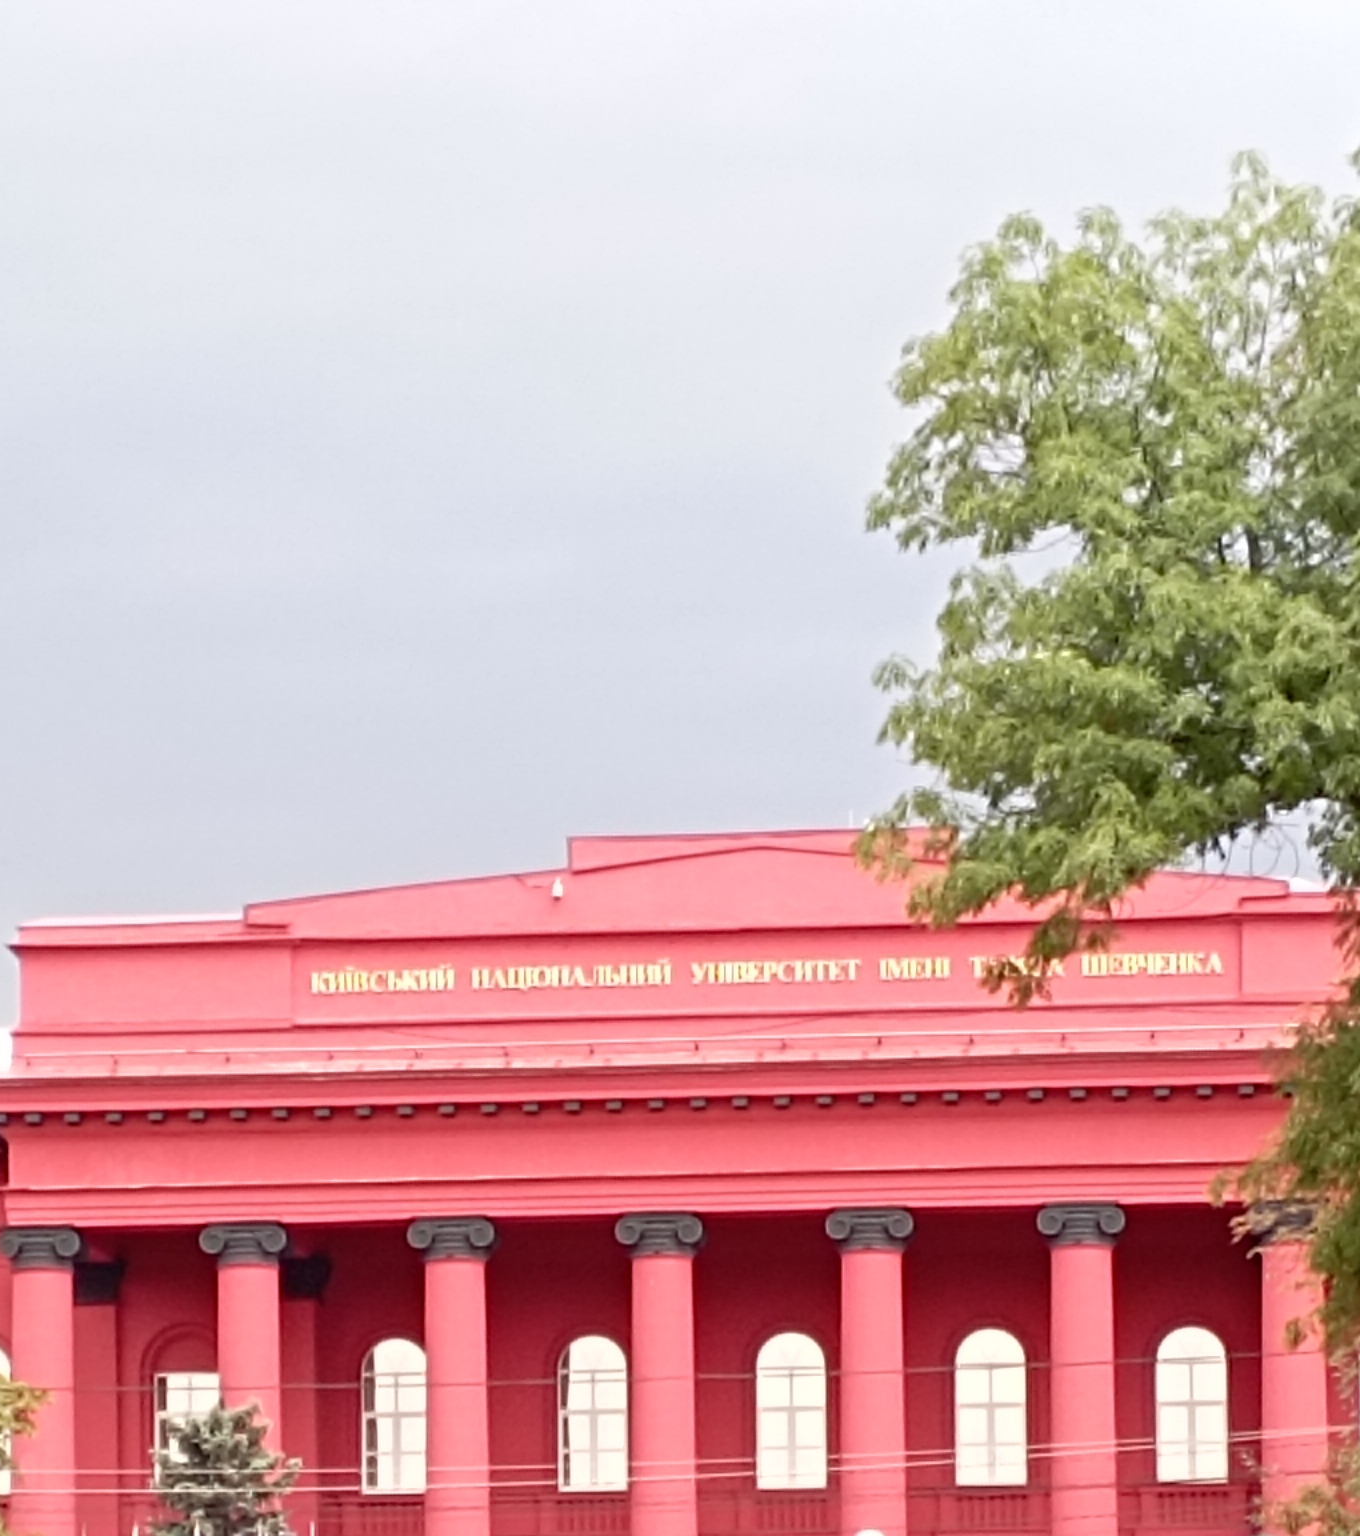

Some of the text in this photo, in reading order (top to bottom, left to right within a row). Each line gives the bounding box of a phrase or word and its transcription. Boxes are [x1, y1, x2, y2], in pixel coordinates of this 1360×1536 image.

[311, 964, 455, 994] КИЇВСЬКИЙ
[471, 958, 672, 990] НАЦІОНАЛЬНИЙ
[691, 959, 861, 984] УНІВЕРСИТЕТ
[879, 957, 950, 980] ІМЕНІ
[1080, 952, 1223, 976] ШЕВЧЕНКА
